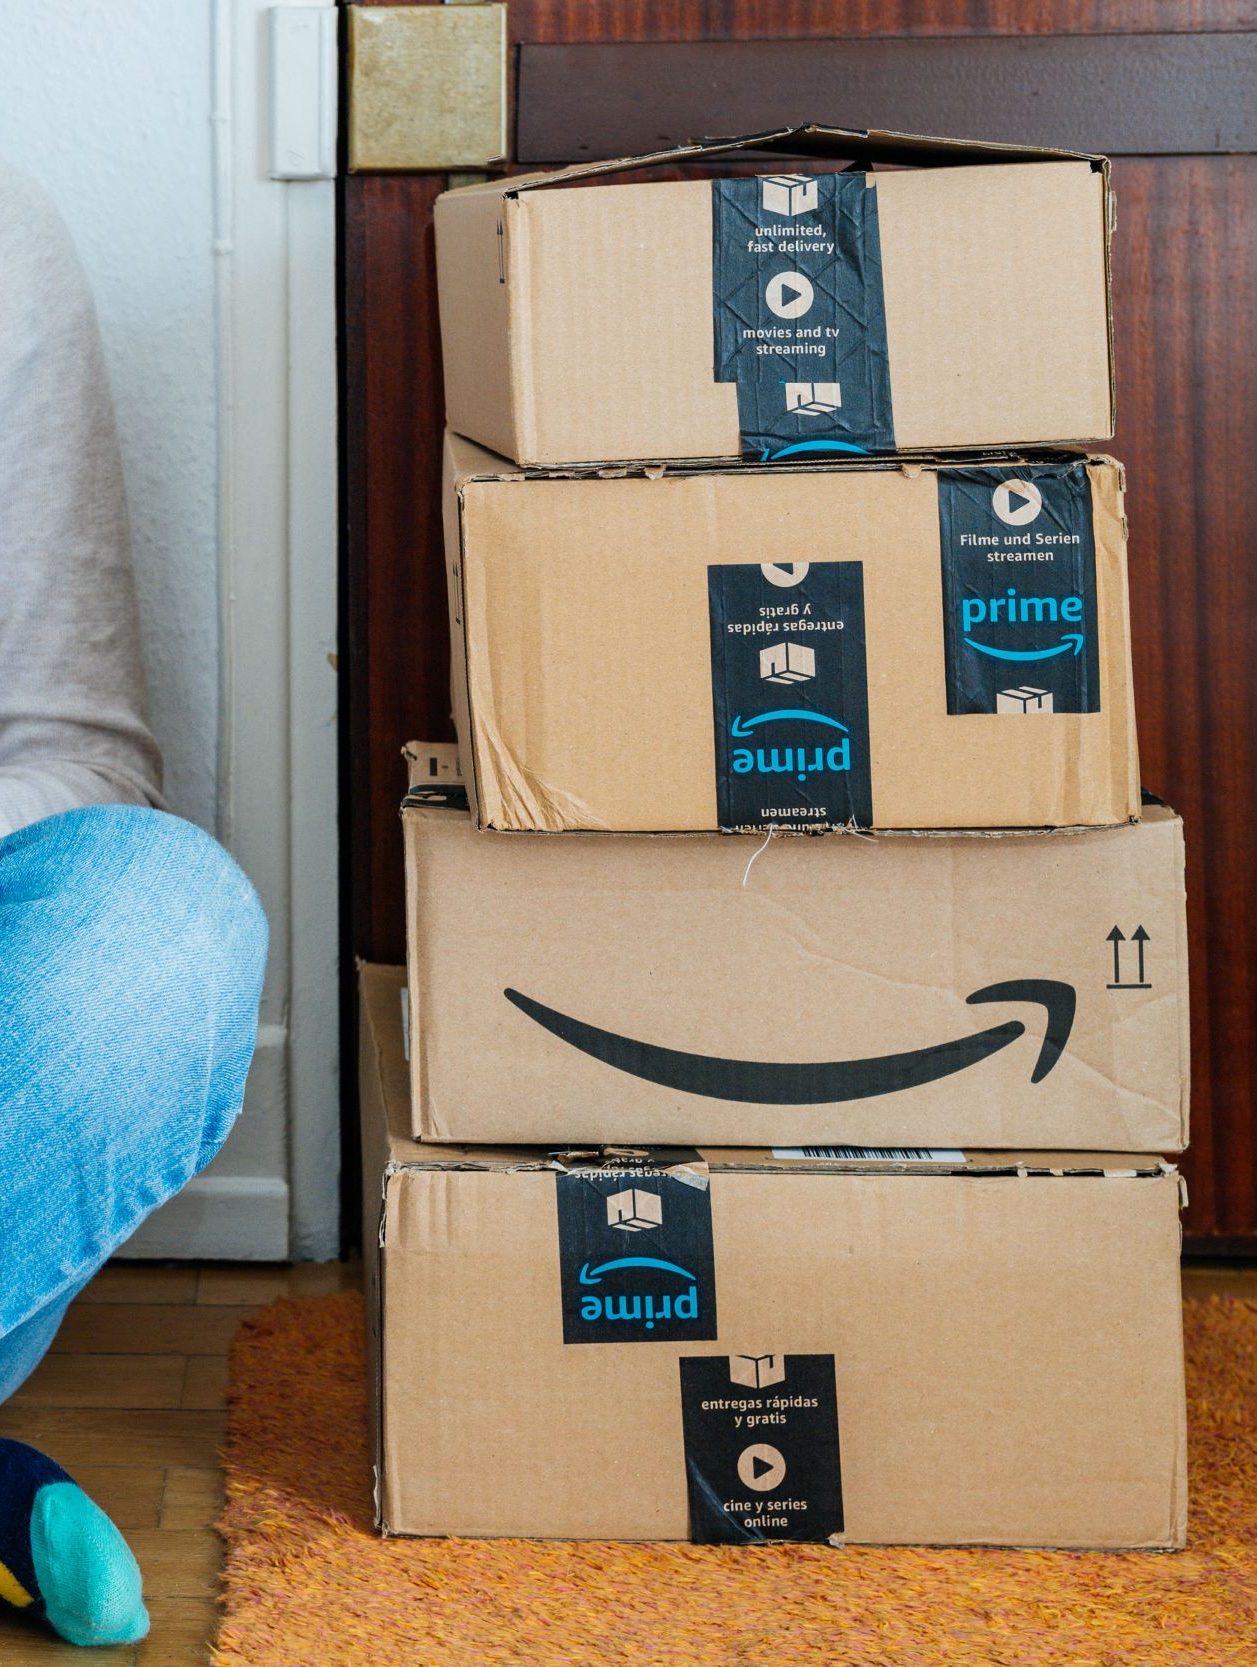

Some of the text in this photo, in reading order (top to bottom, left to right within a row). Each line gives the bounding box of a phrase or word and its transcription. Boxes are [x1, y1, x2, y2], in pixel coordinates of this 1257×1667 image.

[755, 224, 827, 238] unlimited,
[747, 240, 835, 255] fast delivery
[743, 326, 840, 339] movies and tv
[756, 342, 826, 357] streaming
[960, 532, 1080, 546] Filme und Serien
[987, 550, 1054, 562] streamen
[759, 603, 812, 619] y gratis
[962, 588, 1083, 632] prime
[727, 619, 844, 636] entregas rápidas
[732, 737, 852, 782] prime
[761, 806, 827, 818] streamen
[580, 1286, 698, 1329] prime
[701, 1395, 819, 1412] entregas rápidas
[734, 1412, 787, 1428] y gratis
[723, 1498, 808, 1514] cine y series
[744, 1515, 789, 1528] online
